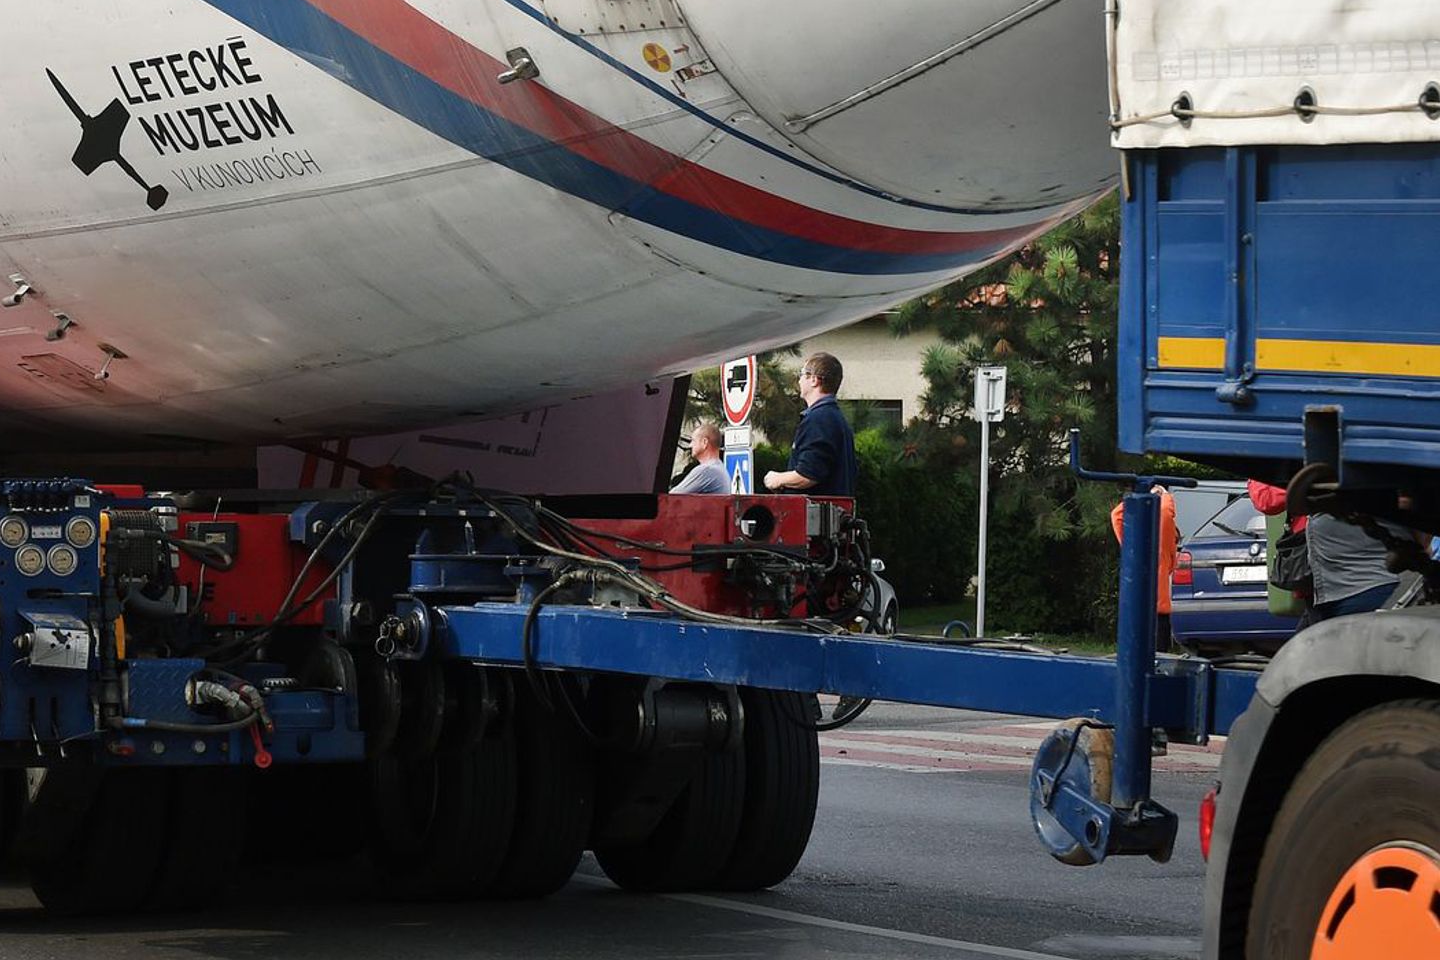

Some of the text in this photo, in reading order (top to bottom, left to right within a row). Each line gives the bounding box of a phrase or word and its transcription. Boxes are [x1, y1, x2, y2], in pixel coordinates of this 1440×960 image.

[111, 36, 263, 105] LETECKÉ
[137, 93, 295, 155] MUZEUM
[189, 147, 322, 191] KUNOVICÍCH
